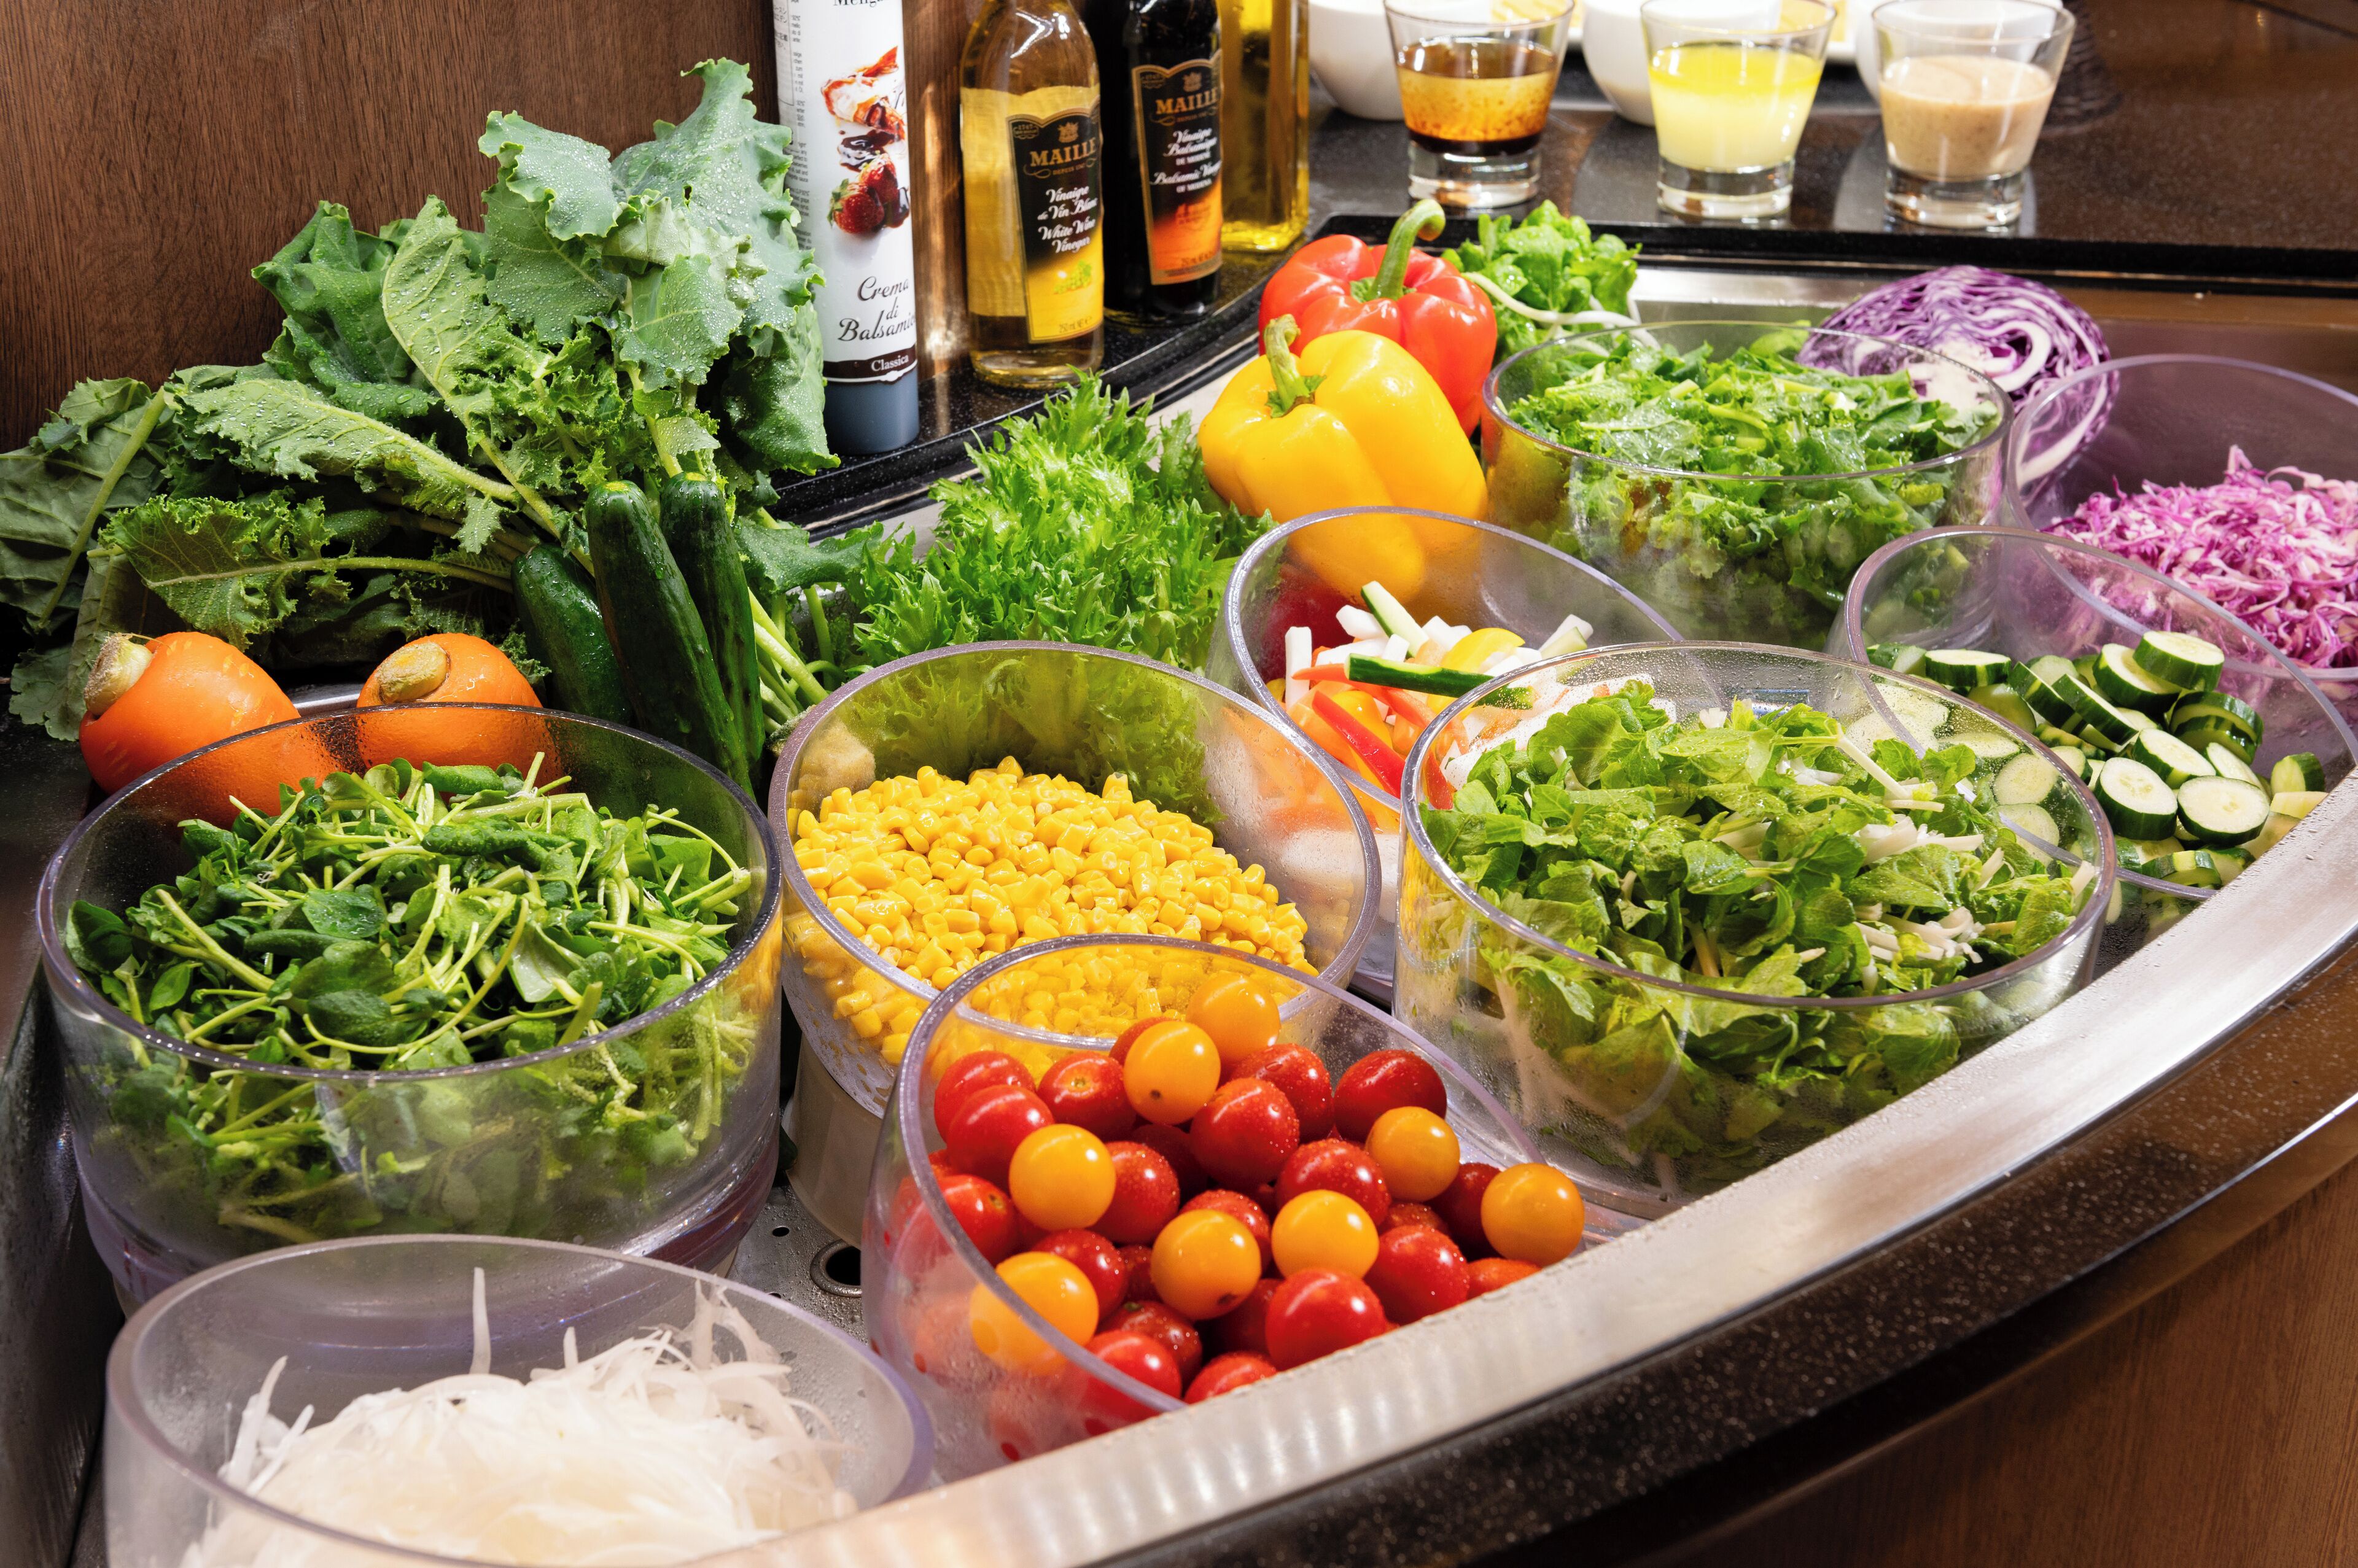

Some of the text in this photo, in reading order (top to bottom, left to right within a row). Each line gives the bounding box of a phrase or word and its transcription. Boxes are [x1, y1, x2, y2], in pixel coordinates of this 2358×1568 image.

[1048, 203, 1070, 219] Vin
[1038, 216, 1095, 241] White Wine
[1052, 236, 1090, 254] Vinegar
[857, 276, 909, 301] Crema
[885, 297, 899, 320] di
[871, 355, 909, 371] Classica
